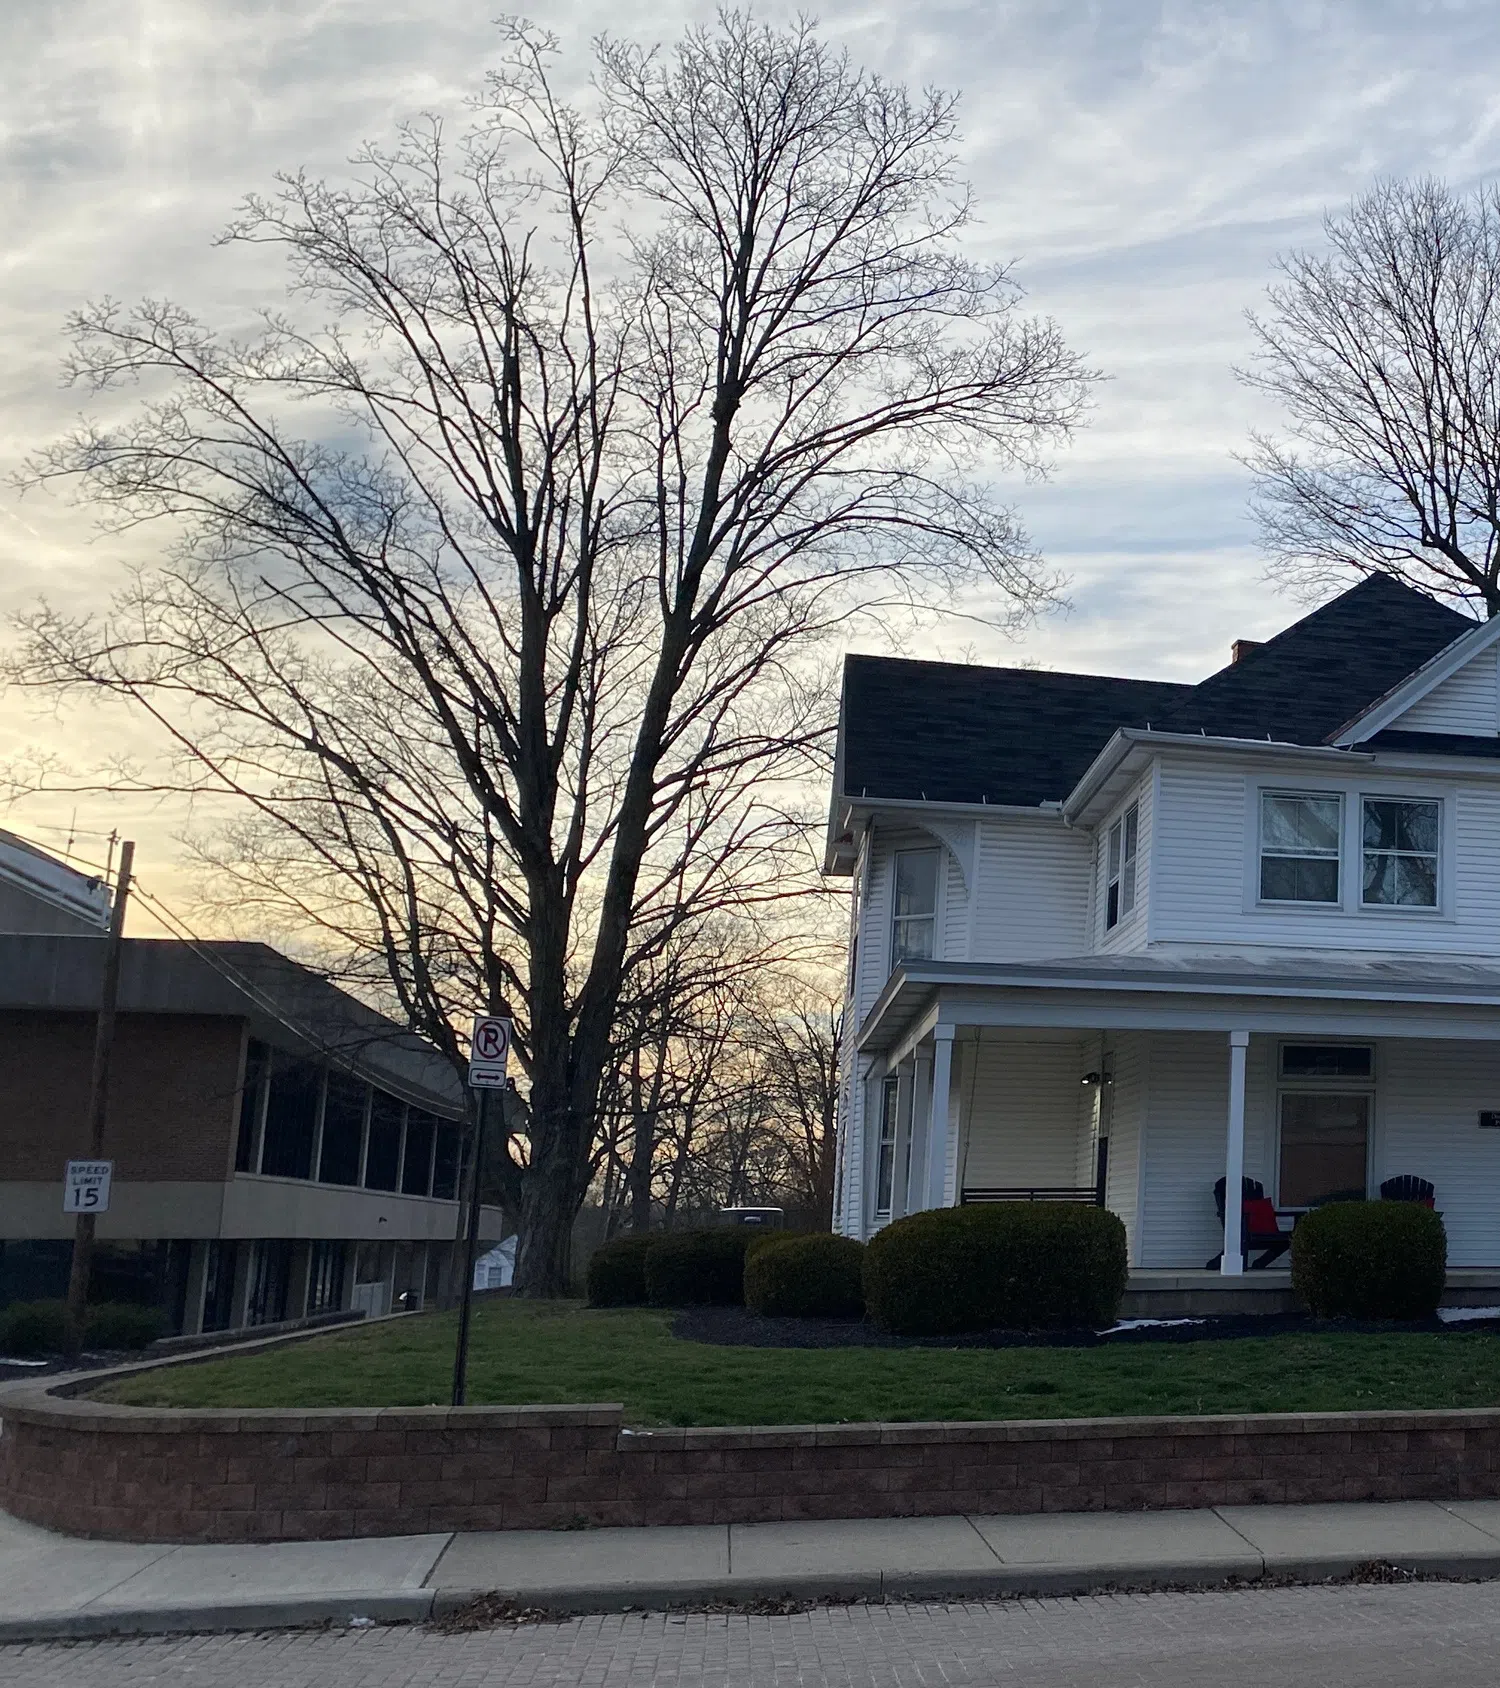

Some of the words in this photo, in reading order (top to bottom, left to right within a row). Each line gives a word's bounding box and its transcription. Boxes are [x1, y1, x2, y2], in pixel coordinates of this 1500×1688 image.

[483, 1028, 498, 1052] P
[71, 1166, 109, 1175] SPEED
[73, 1176, 103, 1185] LIMIT
[74, 1187, 99, 1207] 15
